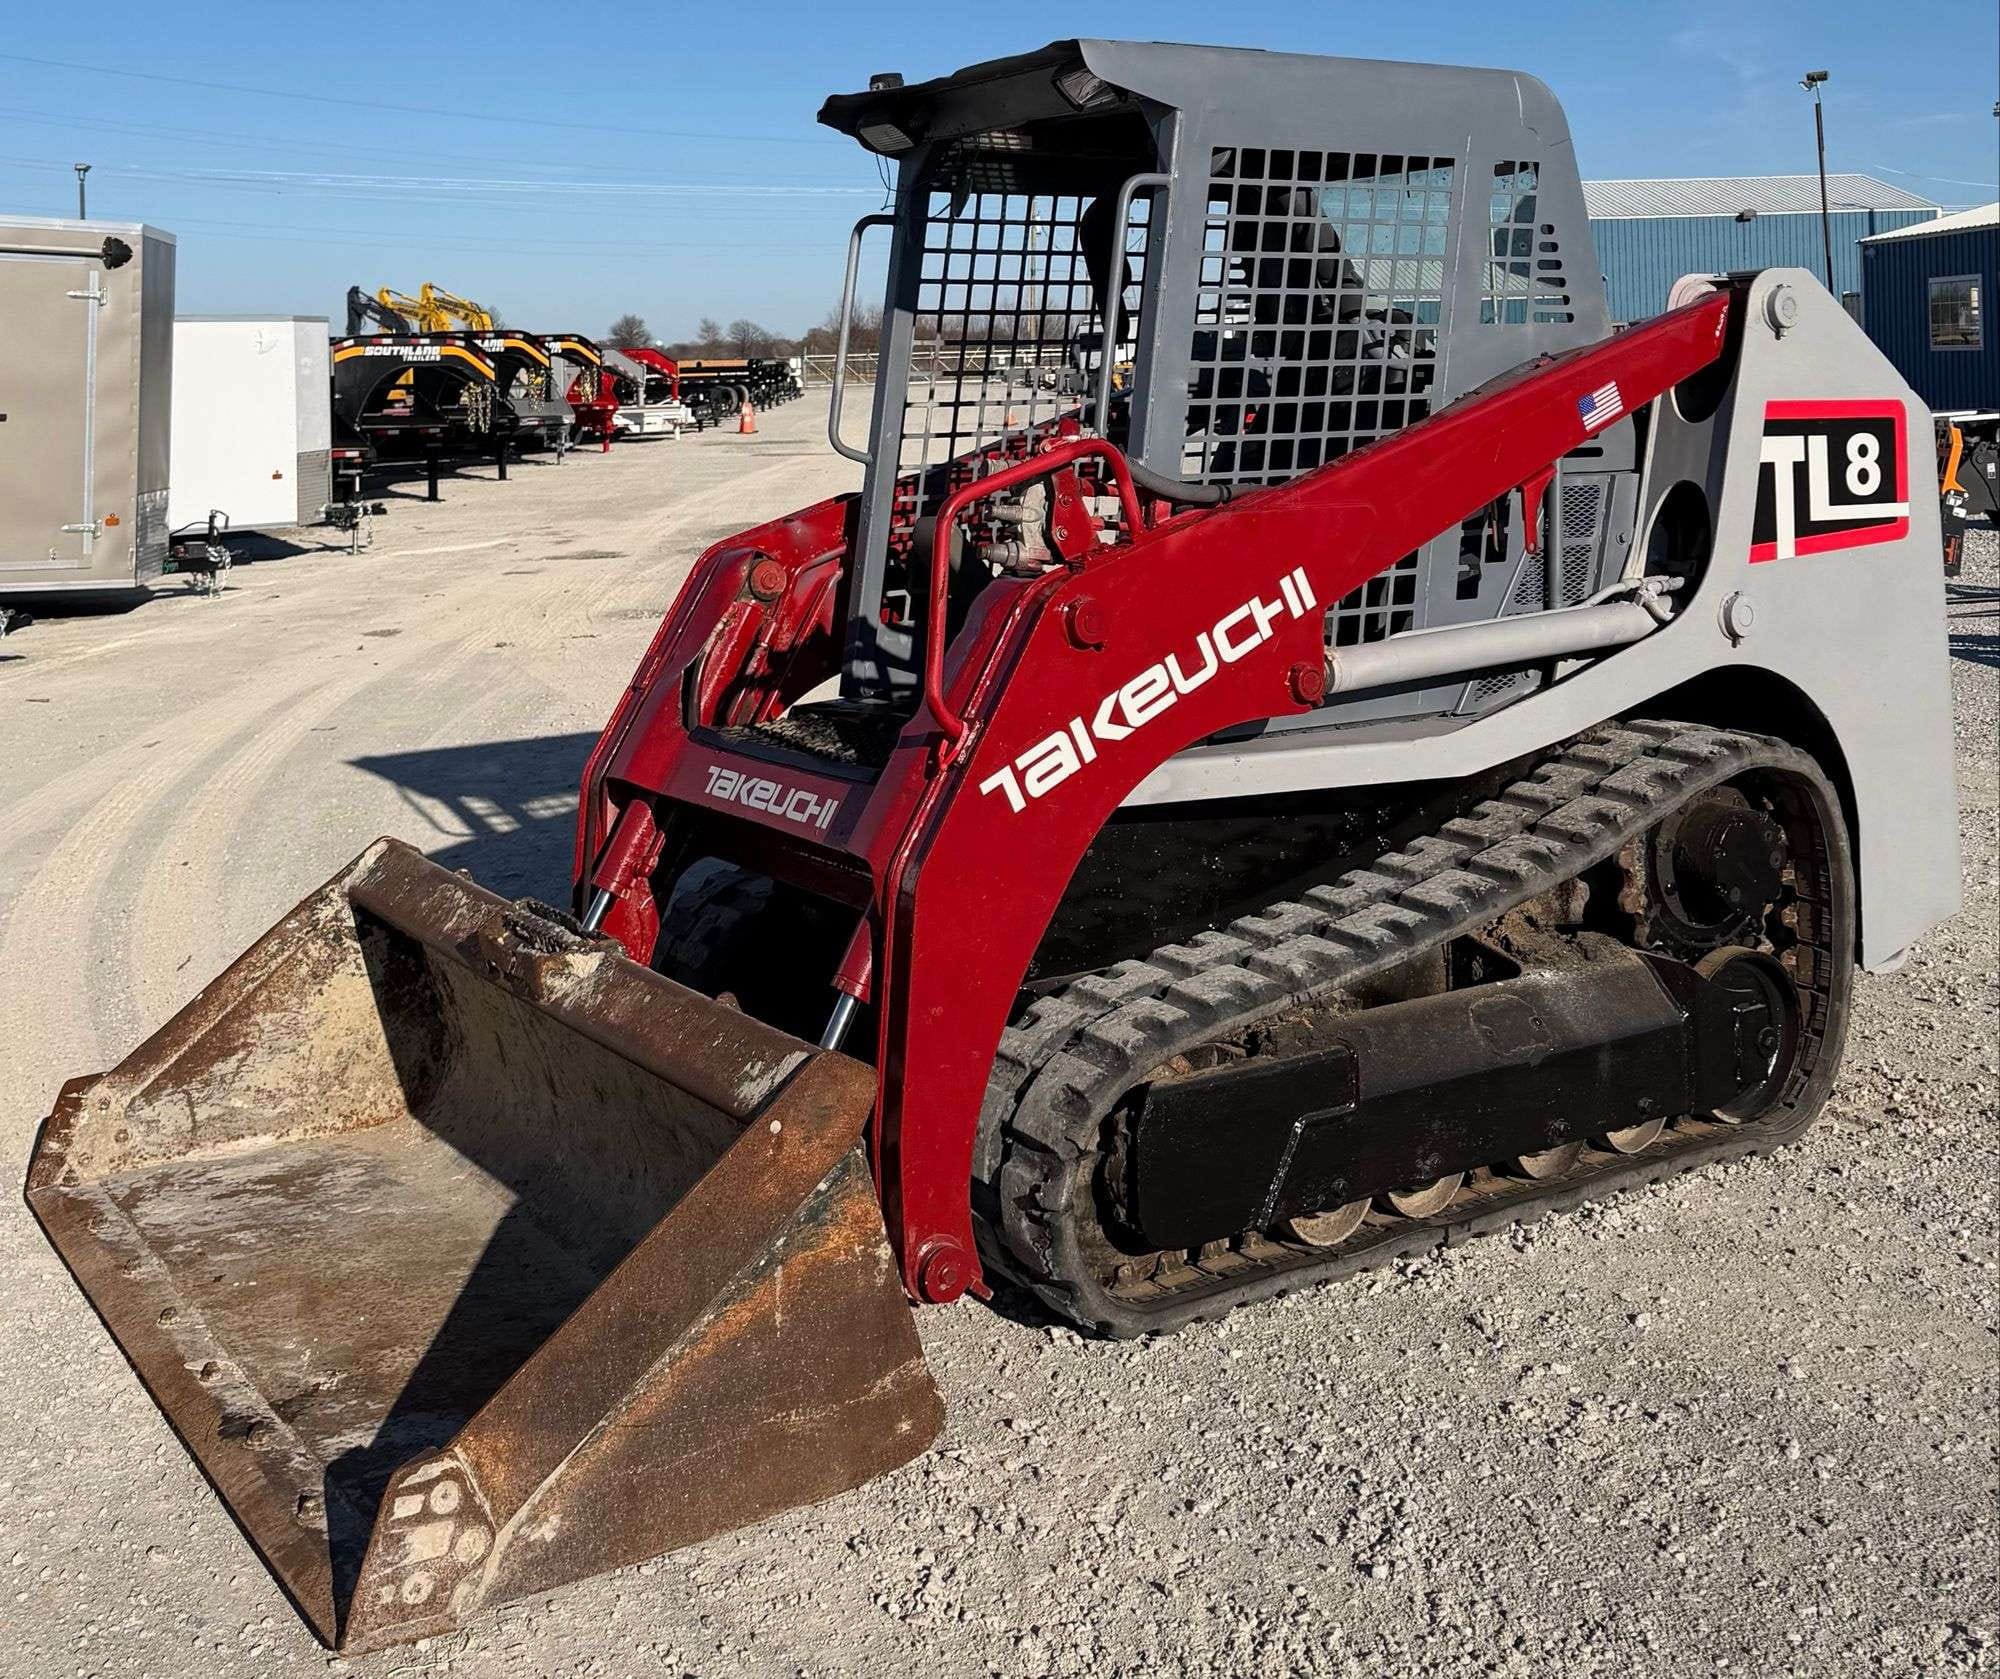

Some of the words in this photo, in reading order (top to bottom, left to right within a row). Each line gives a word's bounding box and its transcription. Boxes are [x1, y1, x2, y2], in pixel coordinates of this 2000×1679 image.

[364, 345, 441, 356] SOUTHLAND
[402, 354, 442, 362] TRAILERS
[979, 566, 1317, 814] TAKEUCHI
[704, 765, 839, 830] TAKEUCHI
